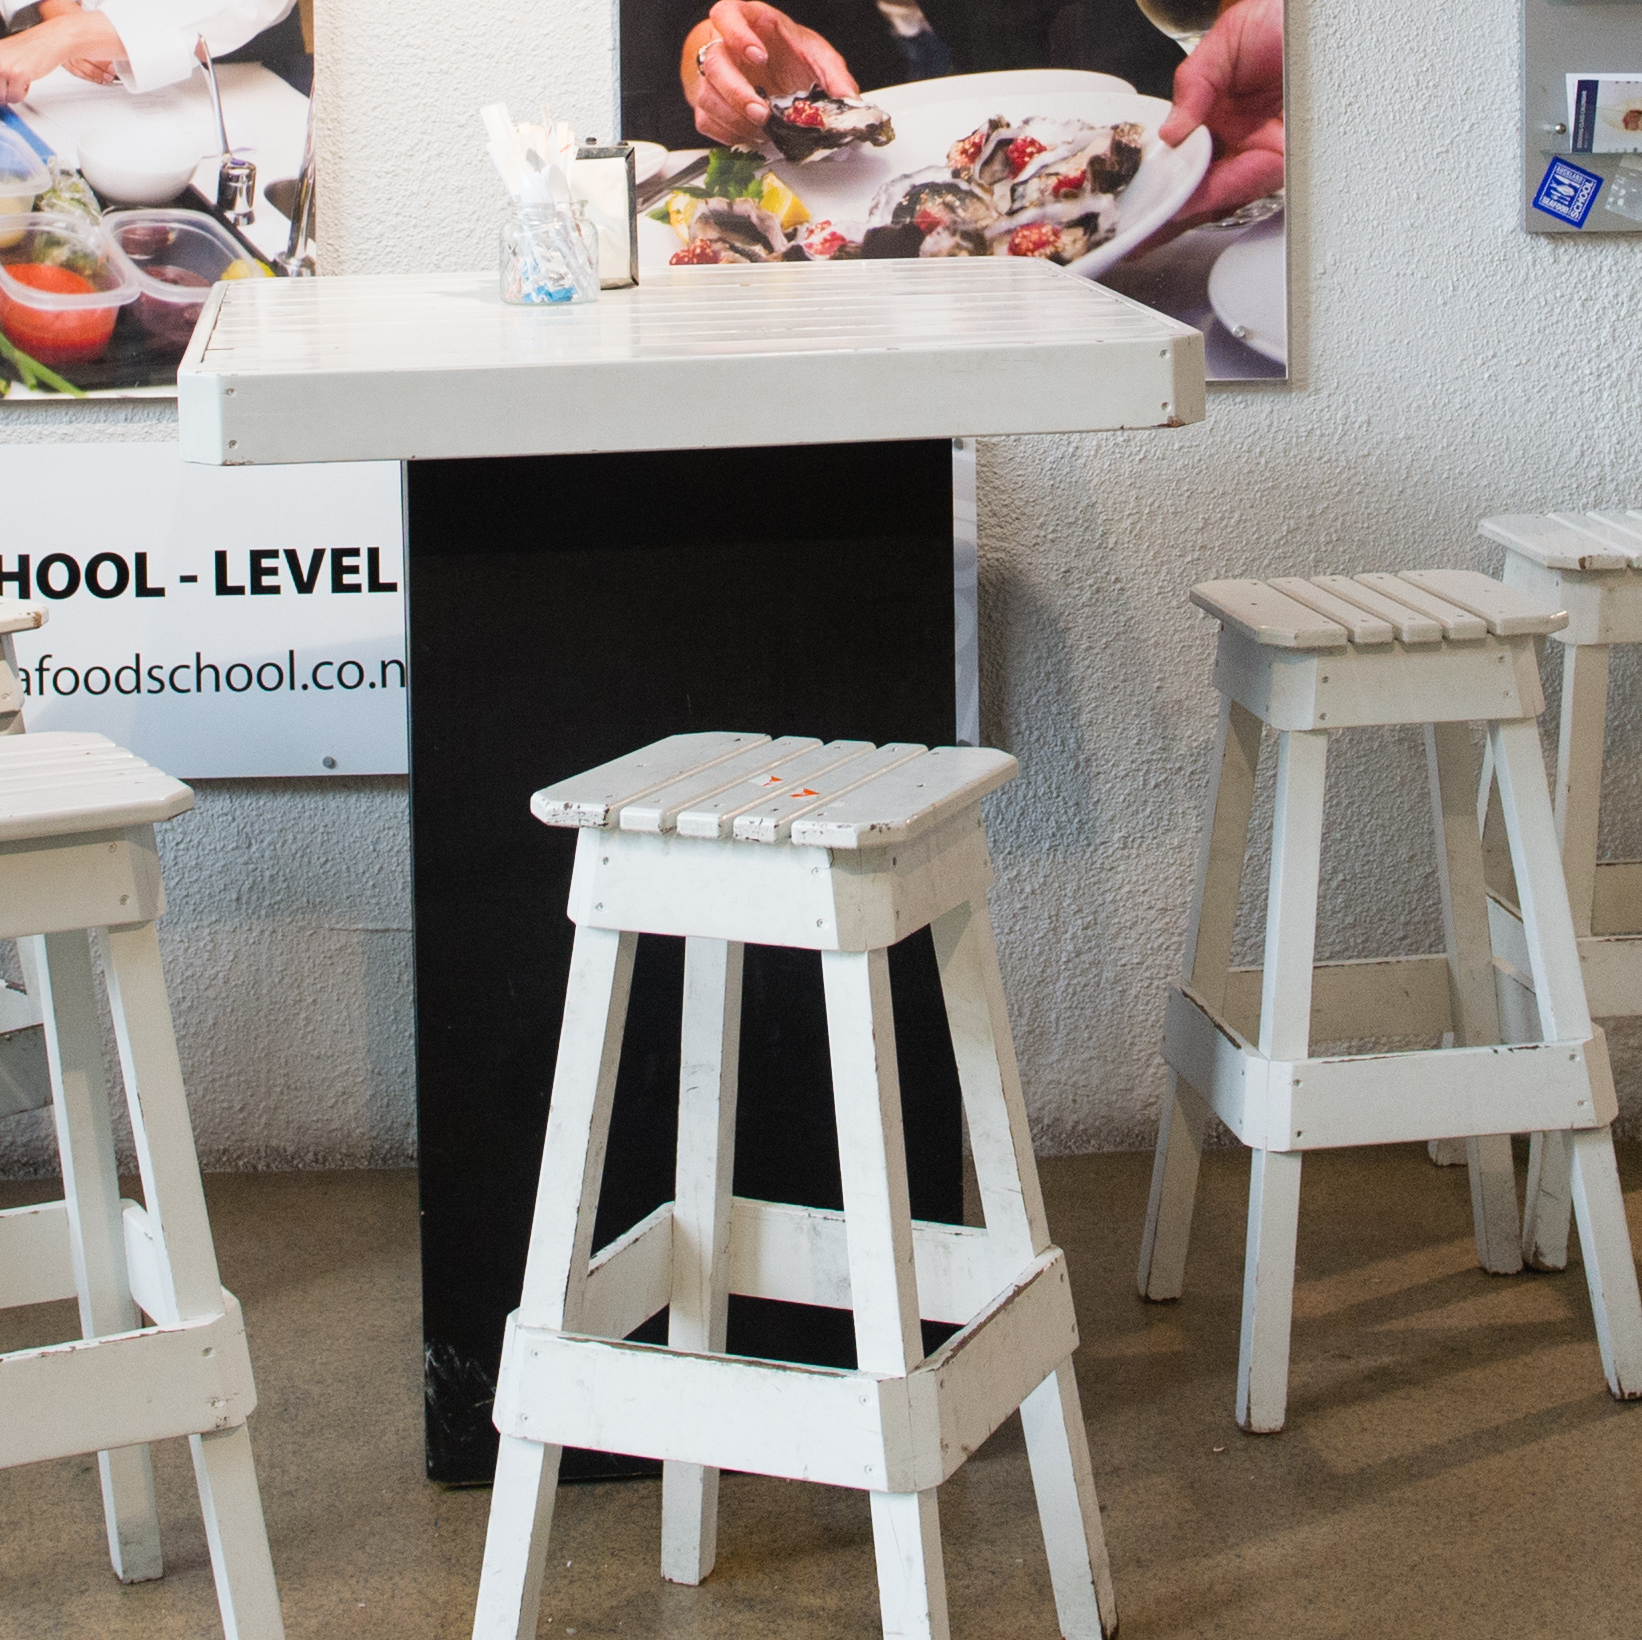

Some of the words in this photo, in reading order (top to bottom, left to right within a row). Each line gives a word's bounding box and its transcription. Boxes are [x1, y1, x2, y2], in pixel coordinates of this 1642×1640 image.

[1541, 196, 1570, 214] SEAFOOD
[1570, 181, 1595, 219] SCHOOL
[214, 546, 398, 596] LEVEL
